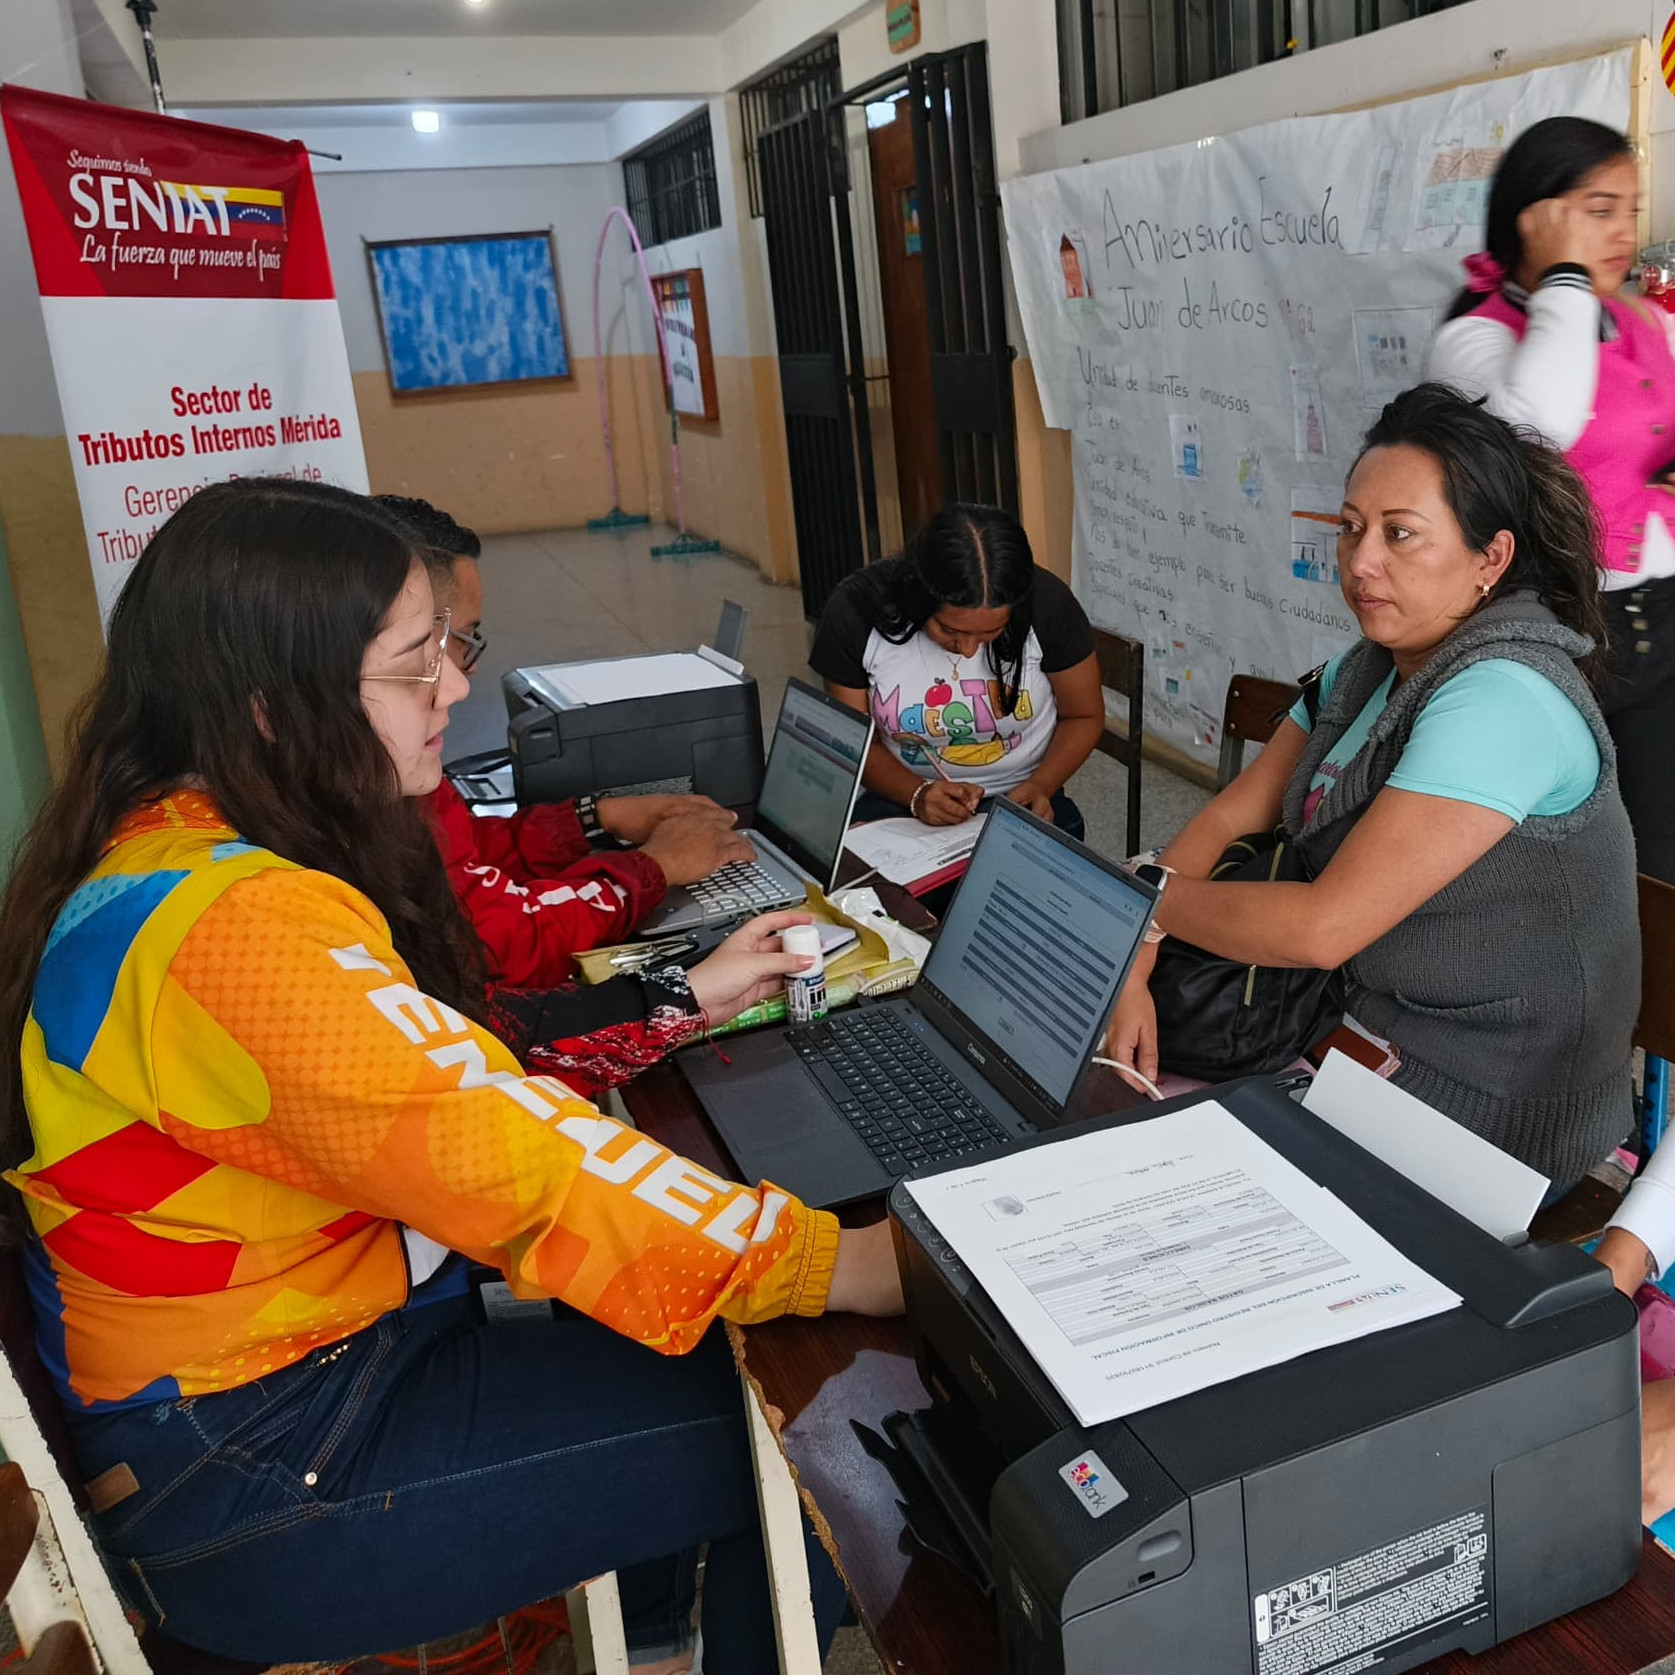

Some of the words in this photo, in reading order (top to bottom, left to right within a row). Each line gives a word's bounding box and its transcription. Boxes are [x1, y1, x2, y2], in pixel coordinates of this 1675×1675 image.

[67, 149, 122, 174] Seguimos
[69, 173, 231, 236] SENIAT
[1258, 176, 1345, 250] Escuela
[80, 234, 106, 263] La
[111, 231, 165, 272] fuerza
[169, 248, 196, 280] que
[199, 248, 244, 268] mueve
[246, 238, 257, 268] el
[259, 248, 282, 282] país
[1178, 277, 1203, 329] de
[1208, 280, 1269, 328] Arcos
[171, 385, 241, 418] Sector
[247, 382, 272, 411] de
[78, 429, 186, 466] Tributos
[191, 423, 277, 455] Internos
[280, 413, 342, 445] Mérida
[1178, 511, 1196, 537] que
